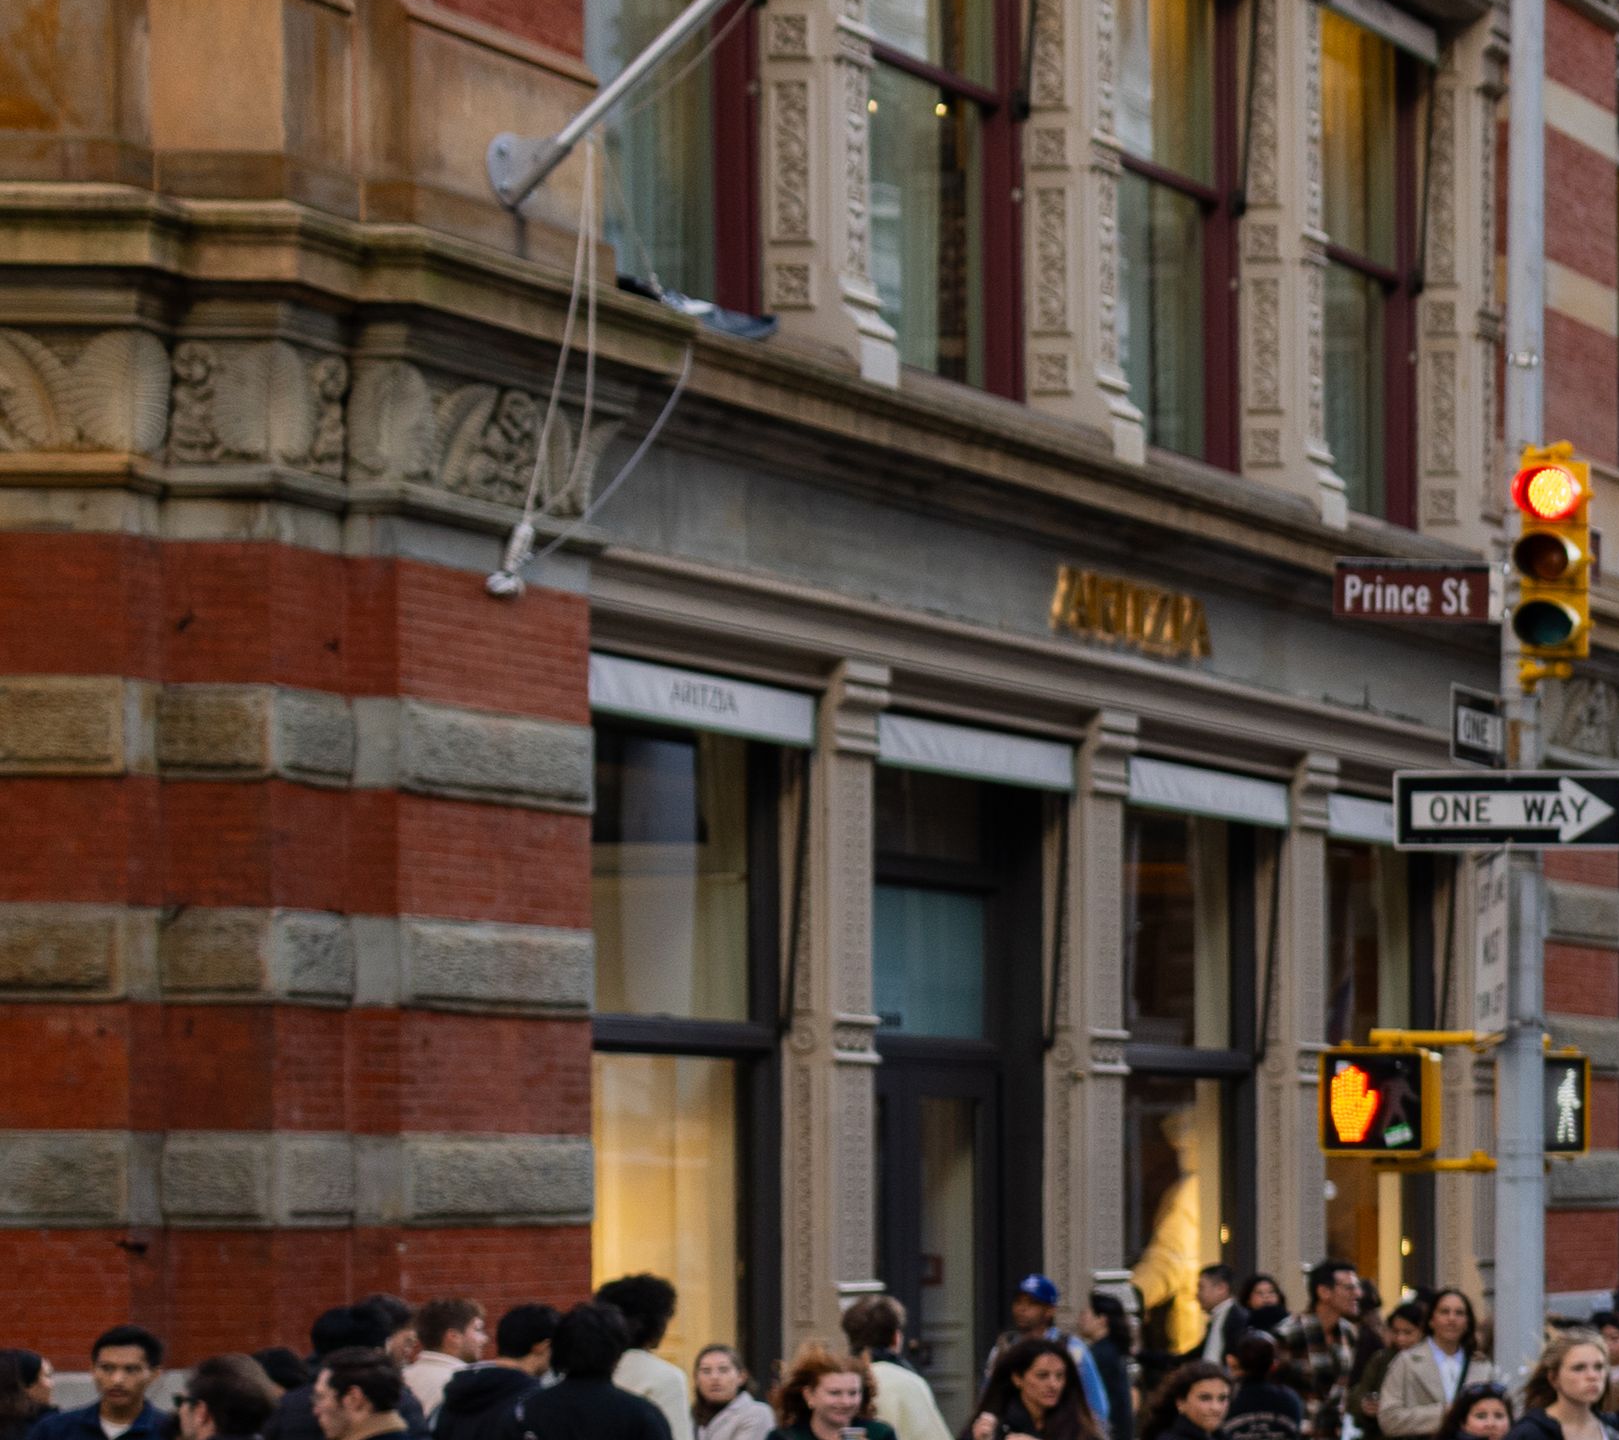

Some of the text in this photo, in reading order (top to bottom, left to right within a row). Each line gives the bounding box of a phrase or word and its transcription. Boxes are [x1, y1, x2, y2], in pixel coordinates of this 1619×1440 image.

[1343, 574, 1471, 616] Prince St
[1462, 714, 1489, 745] ONE
[1429, 795, 1590, 823] ONE WAY
